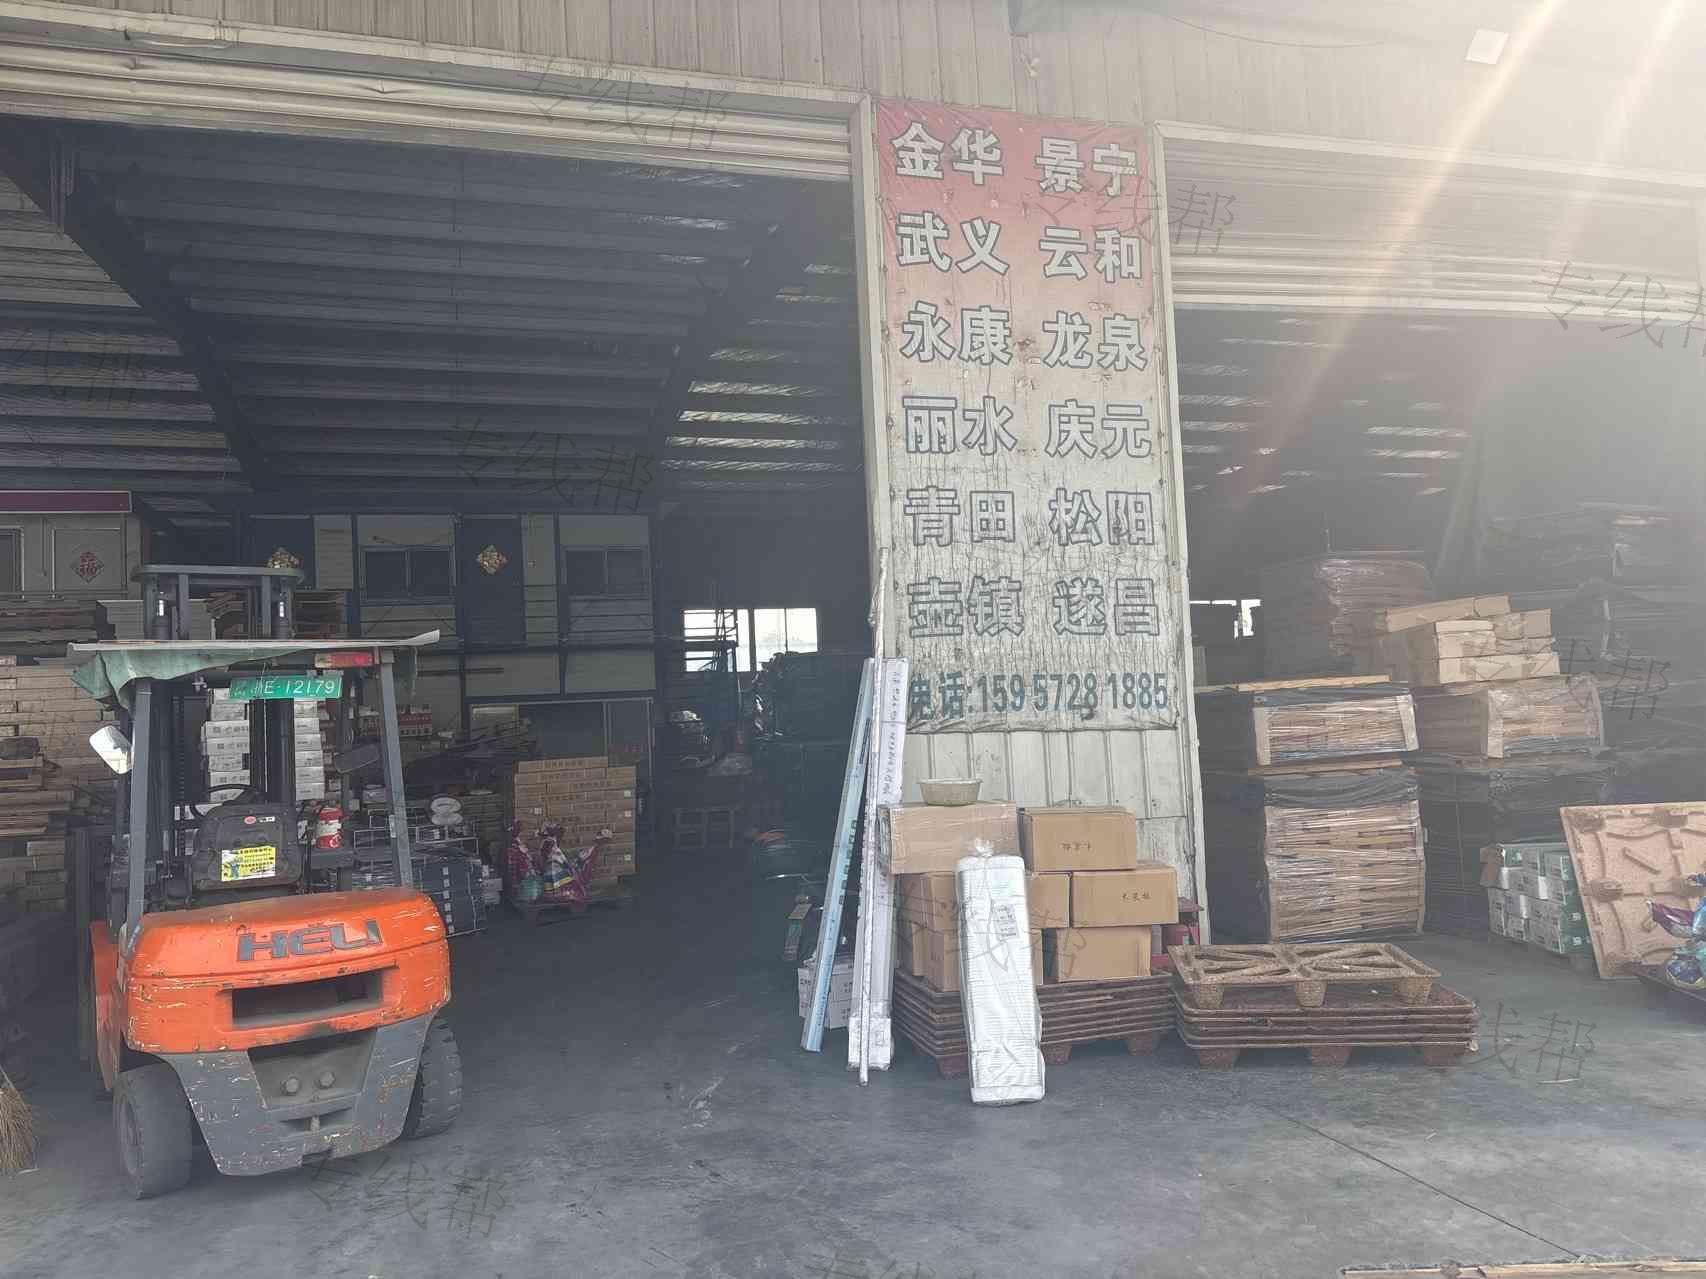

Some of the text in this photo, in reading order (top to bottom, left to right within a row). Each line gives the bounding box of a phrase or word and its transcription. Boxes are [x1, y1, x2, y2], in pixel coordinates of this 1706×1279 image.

[891, 120, 1138, 197] 金华 景宁
[895, 210, 1142, 283] 武义 云和
[900, 300, 1148, 371] 永康 龙泉
[902, 395, 1152, 458] 丽水 庆元
[903, 485, 1155, 547] 青田 松阳
[907, 576, 1160, 638] 壶镇 遂昌
